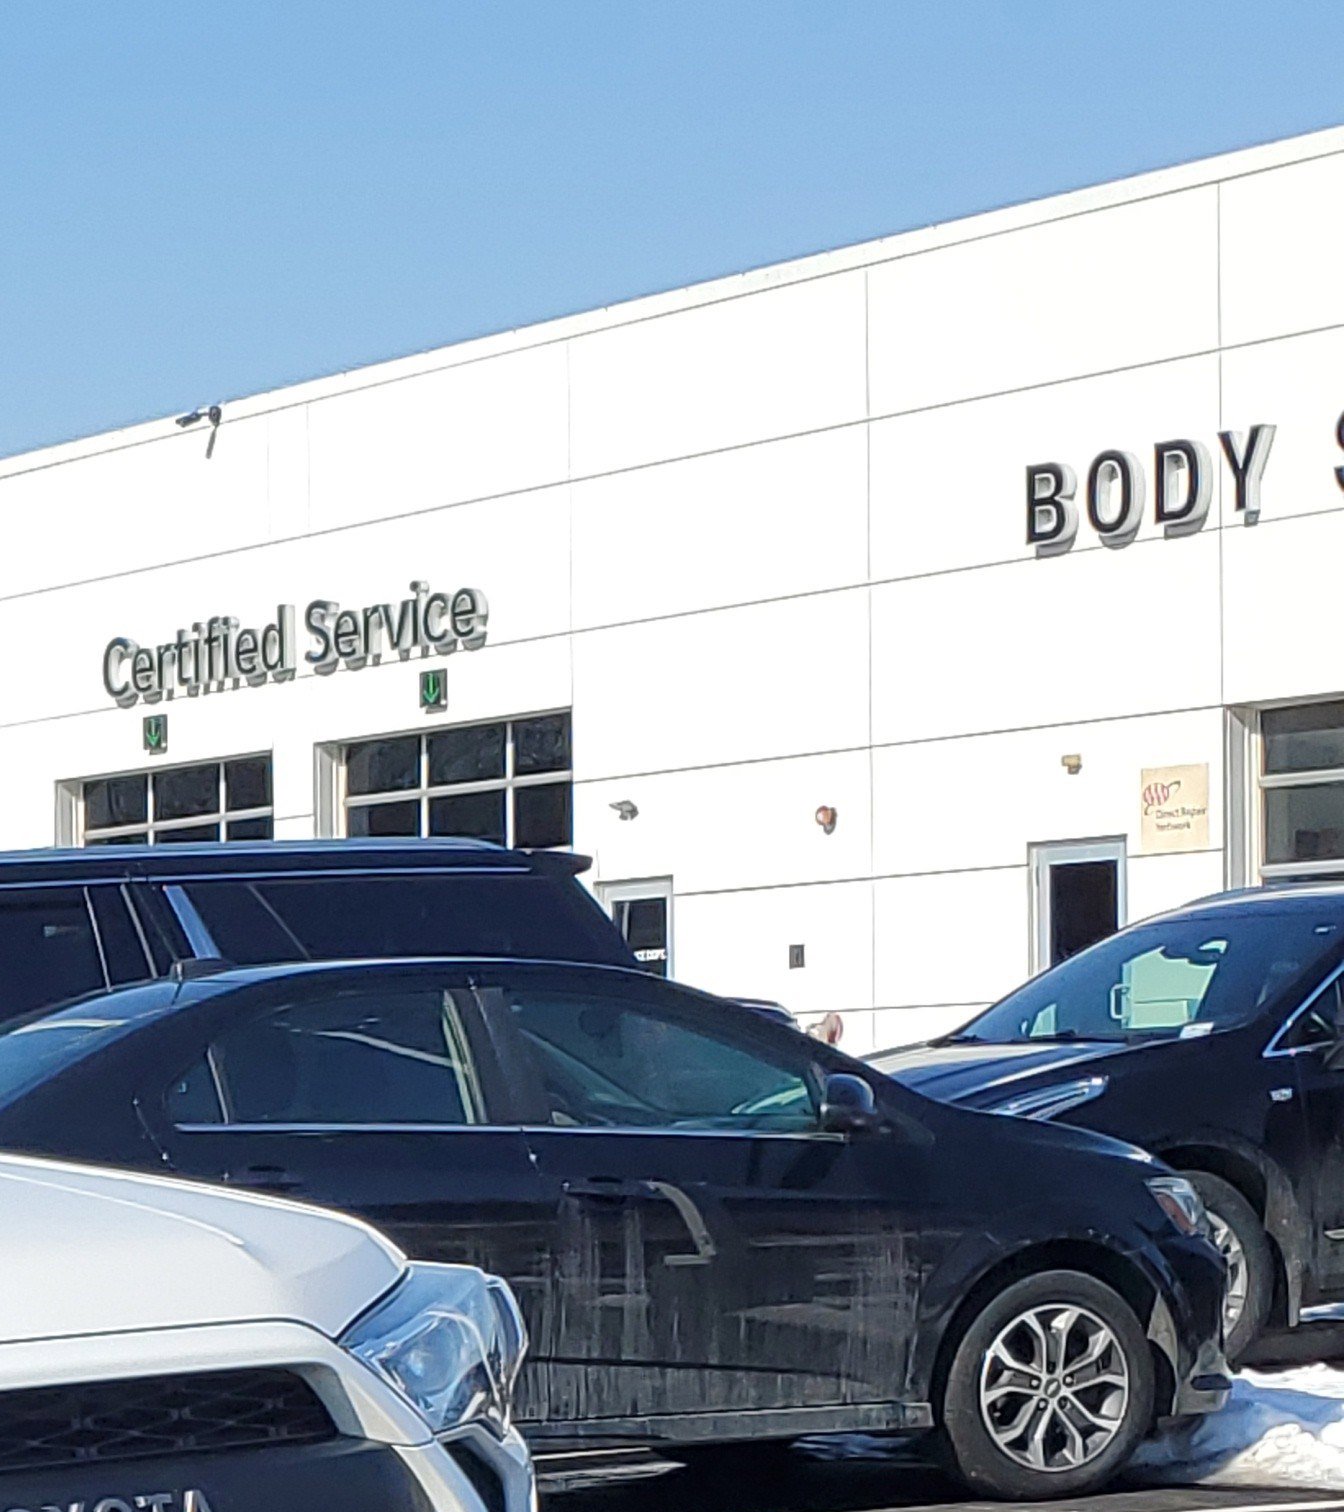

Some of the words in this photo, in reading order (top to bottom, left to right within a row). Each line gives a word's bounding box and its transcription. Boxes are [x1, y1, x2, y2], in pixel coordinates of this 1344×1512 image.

[1025, 423, 1277, 549] BODY
[102, 602, 296, 702] Certified
[304, 579, 490, 669] Service
